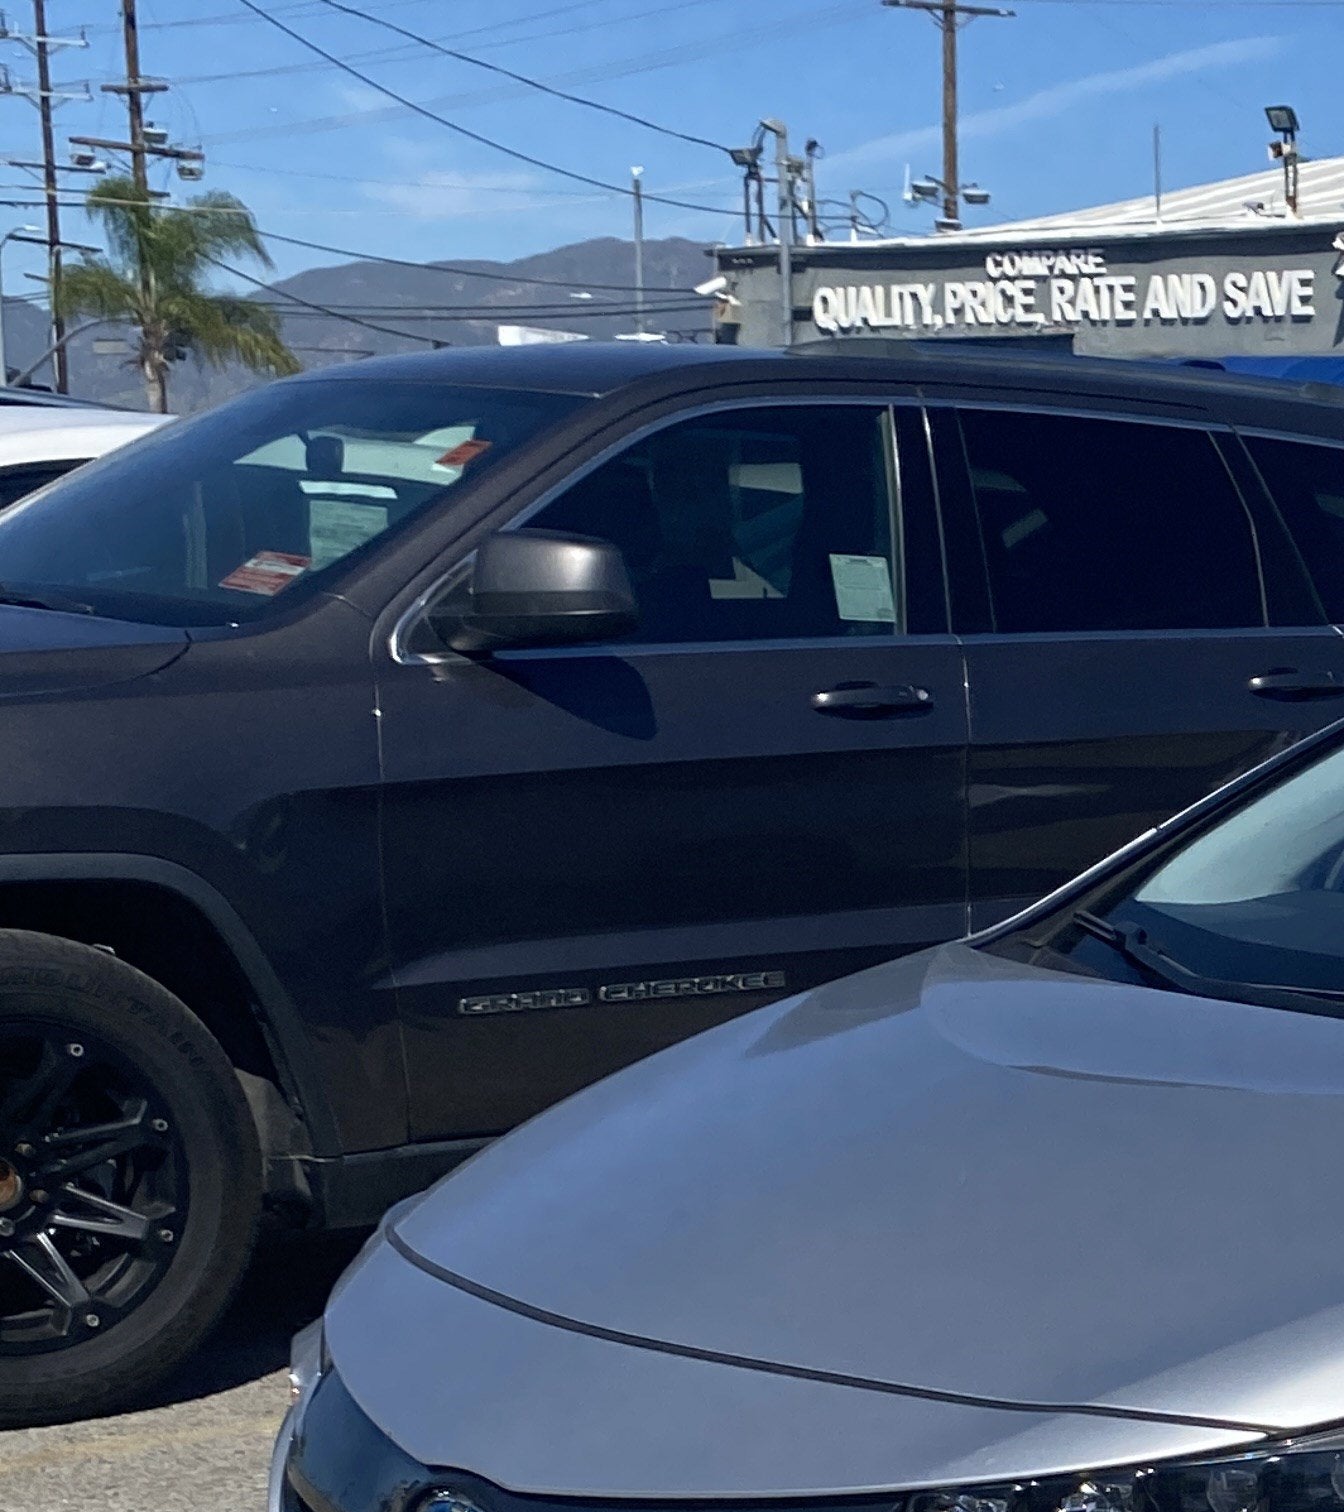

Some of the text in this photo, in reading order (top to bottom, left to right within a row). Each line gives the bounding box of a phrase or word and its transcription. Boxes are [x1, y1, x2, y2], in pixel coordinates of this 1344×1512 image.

[985, 249, 1107, 278] COMPARE
[812, 269, 1316, 332] QUALITY, PRICE, RATE AND SAVE
[458, 970, 786, 1014] GRAND CHEROKEE
